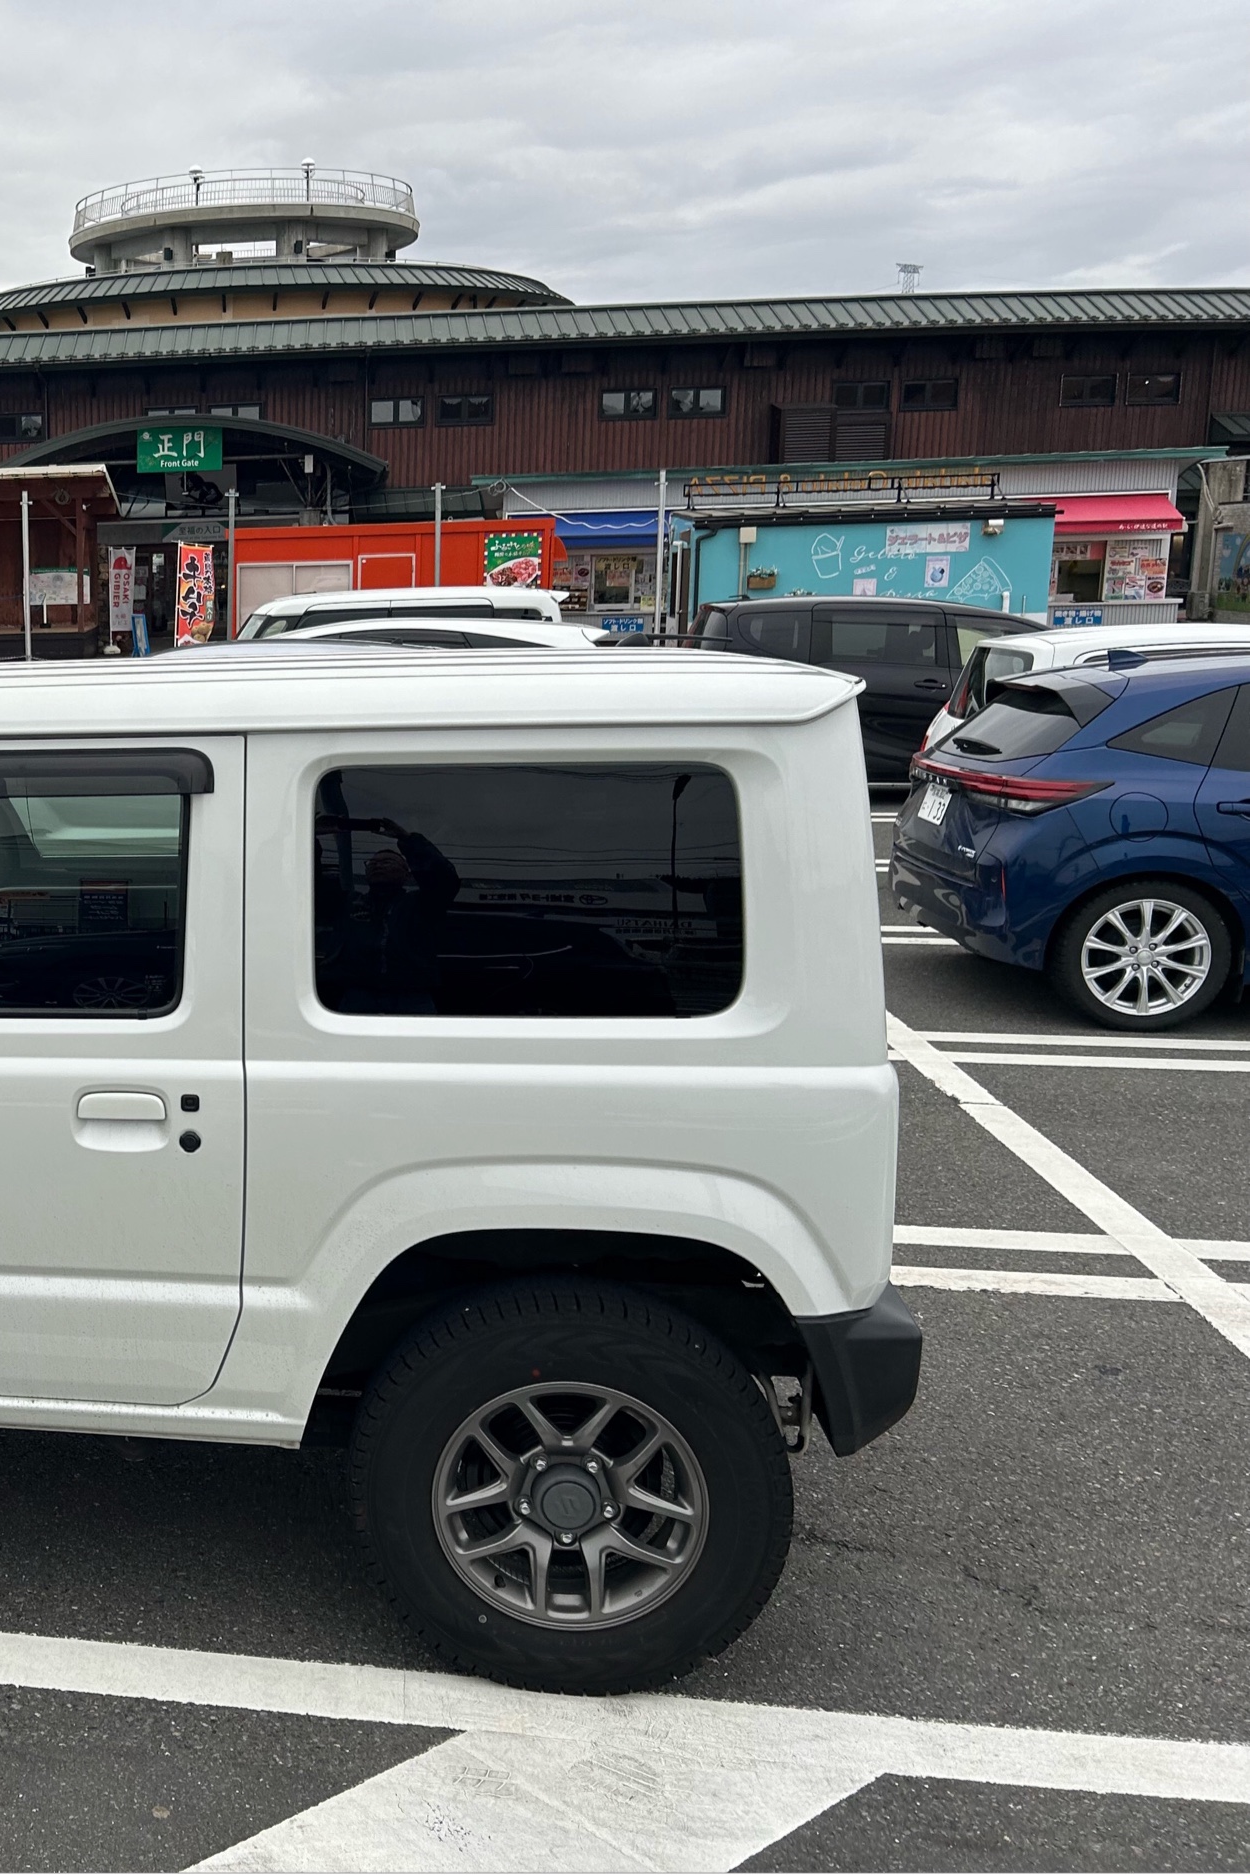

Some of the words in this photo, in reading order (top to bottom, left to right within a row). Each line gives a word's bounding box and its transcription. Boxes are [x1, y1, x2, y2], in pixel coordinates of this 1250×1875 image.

[153, 430, 205, 458] 正門
[160, 460, 180, 468] Front
[181, 459, 199, 467] Gate
[112, 572, 121, 608] GIBIER
[122, 572, 130, 605] OSAKI
